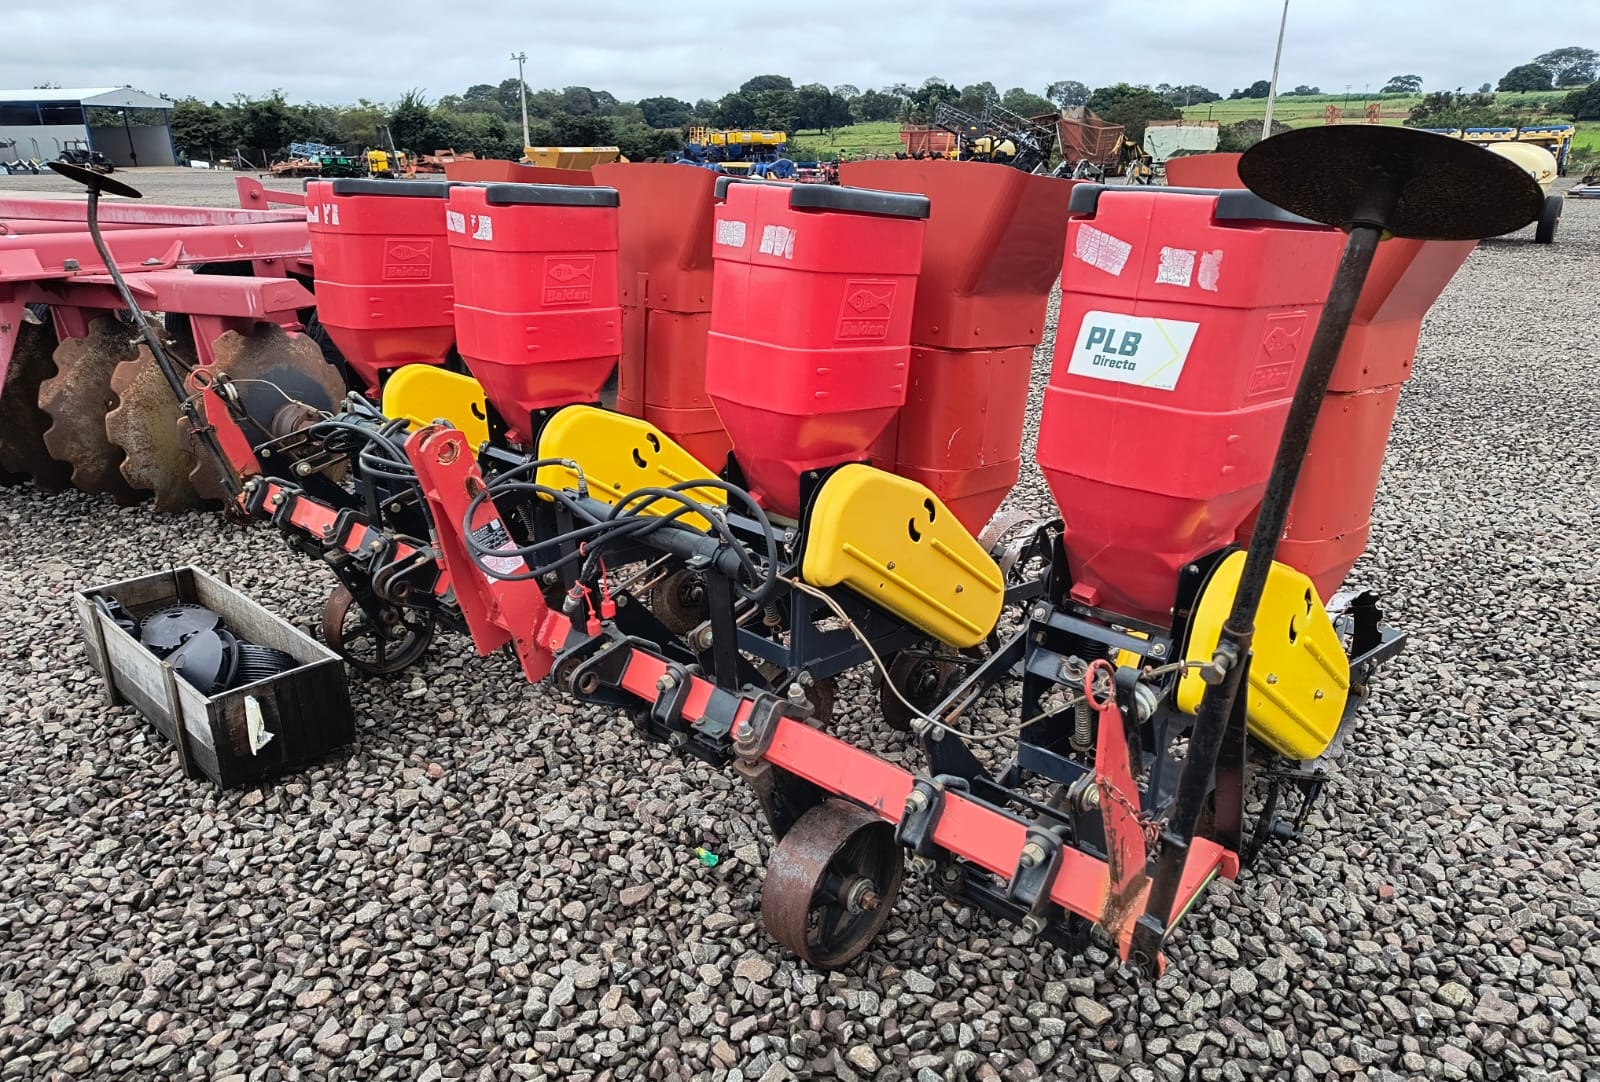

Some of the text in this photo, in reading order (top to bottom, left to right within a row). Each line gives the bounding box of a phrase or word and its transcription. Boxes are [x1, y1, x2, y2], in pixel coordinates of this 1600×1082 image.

[546, 288, 589, 302] Baldan
[840, 321, 885, 337] Baldan
[1085, 326, 1143, 357] PLB
[1092, 354, 1137, 371] Directa
